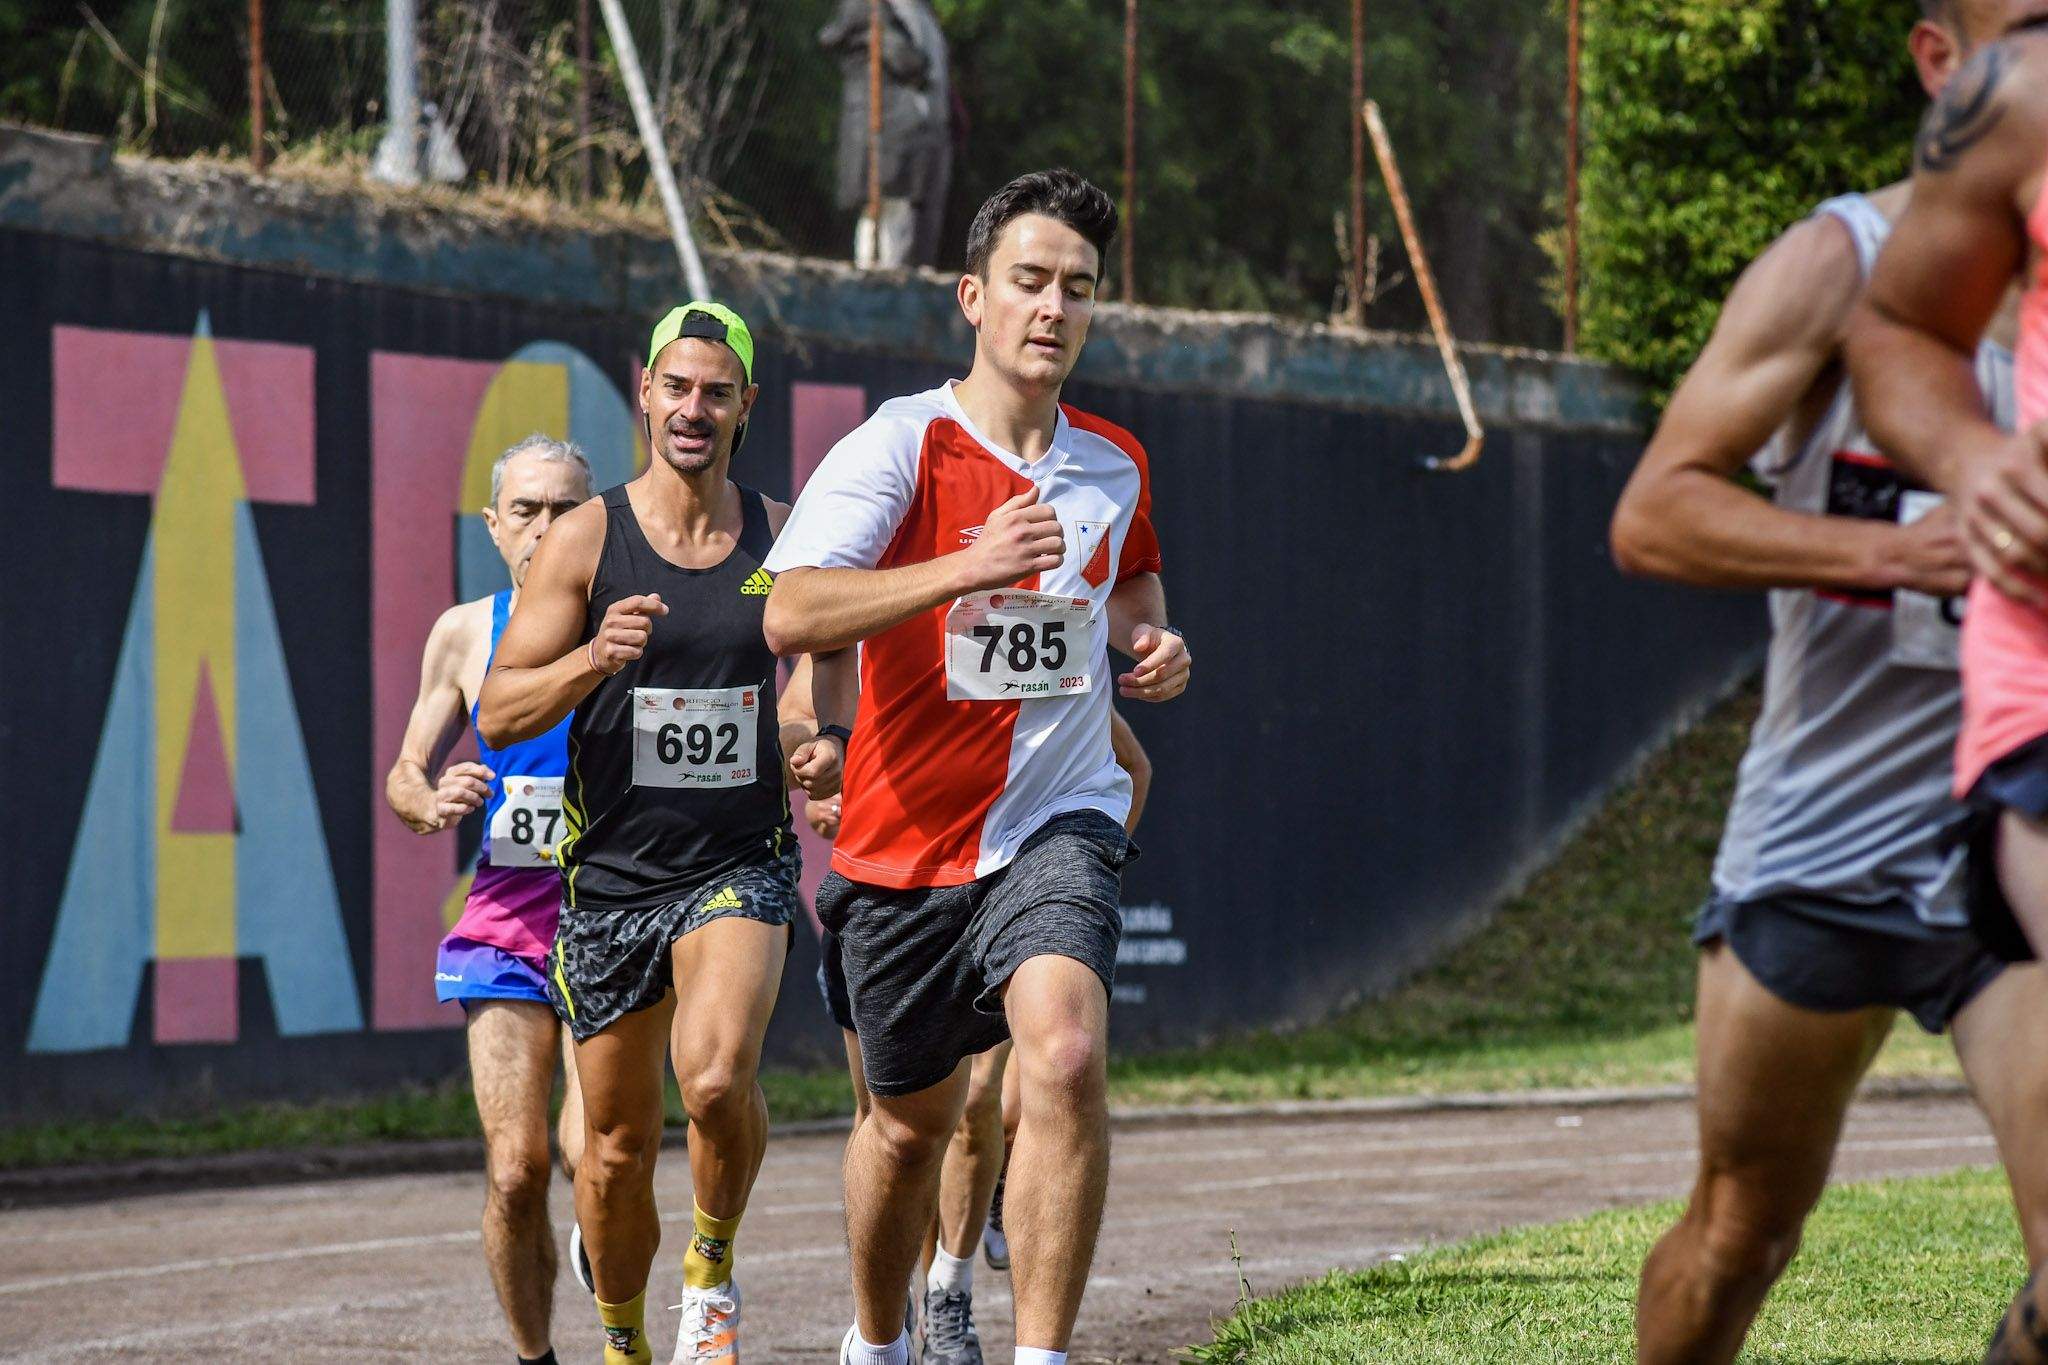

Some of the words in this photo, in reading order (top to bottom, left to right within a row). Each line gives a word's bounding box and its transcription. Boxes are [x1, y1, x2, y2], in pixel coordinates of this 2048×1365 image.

[740, 584, 771, 595] adid
[973, 621, 1067, 673] 785
[1021, 681, 1049, 692] rasán
[1059, 676, 1084, 688] 2023
[656, 722, 739, 765] 692
[696, 772, 722, 782] rasán
[731, 768, 751, 779] 2023
[511, 807, 562, 845] 87
[700, 900, 743, 913] adidas
